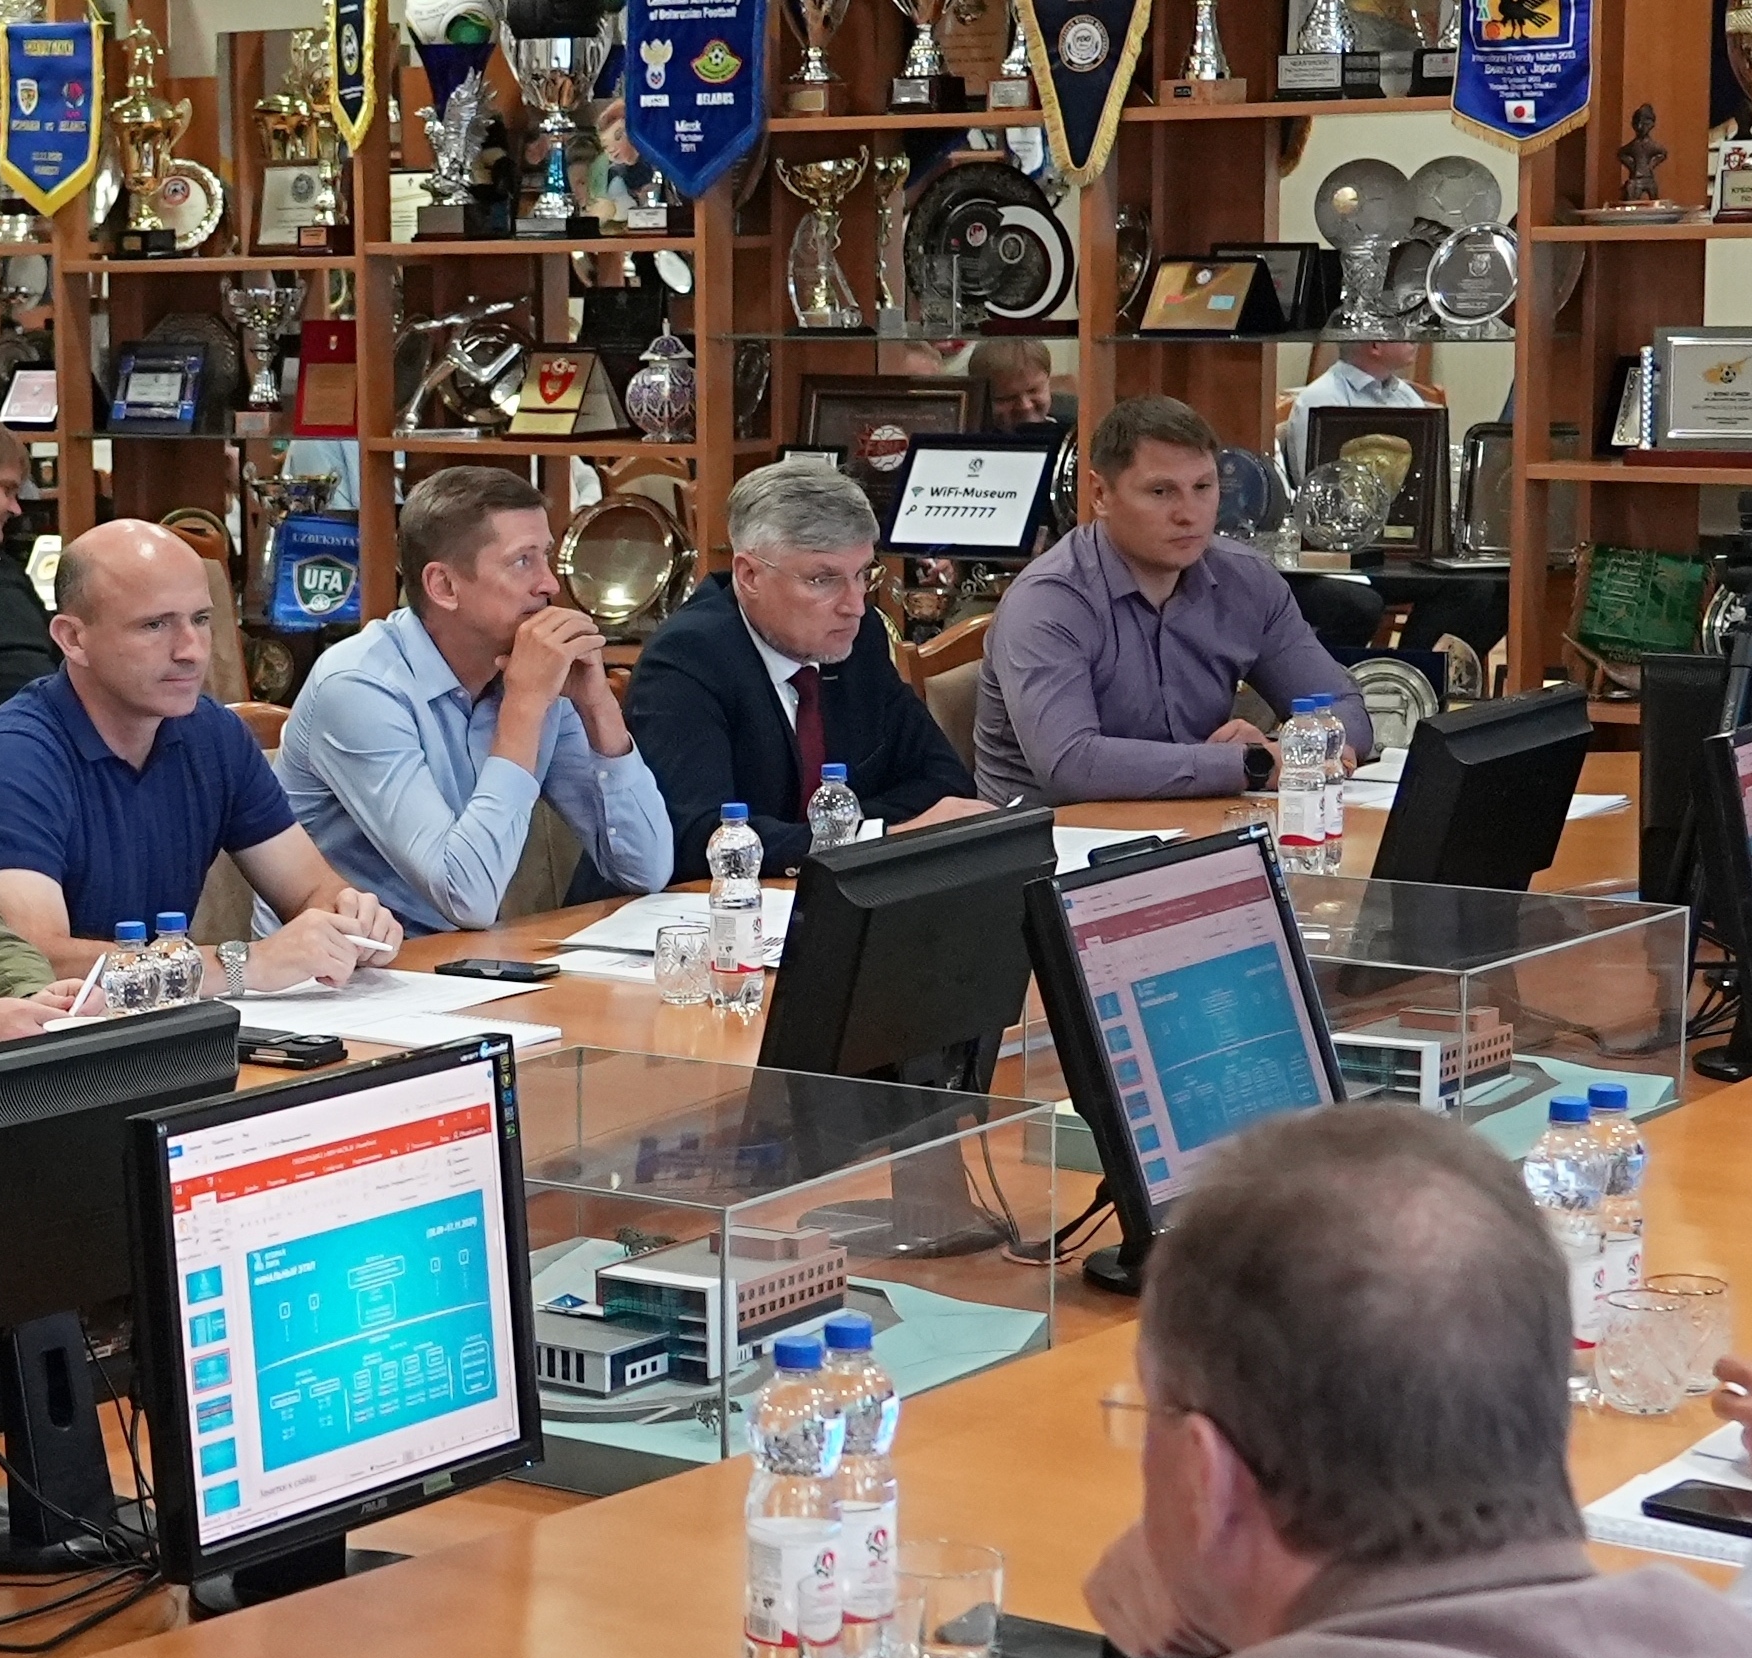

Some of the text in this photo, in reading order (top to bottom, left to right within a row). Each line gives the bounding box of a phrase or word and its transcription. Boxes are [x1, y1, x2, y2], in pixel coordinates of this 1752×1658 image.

[930, 485, 1017, 500] WiFi-Museum
[925, 505, 997, 519] 77777777
[292, 532, 359, 547] UZBEKISTA
[303, 567, 344, 593] UFA
